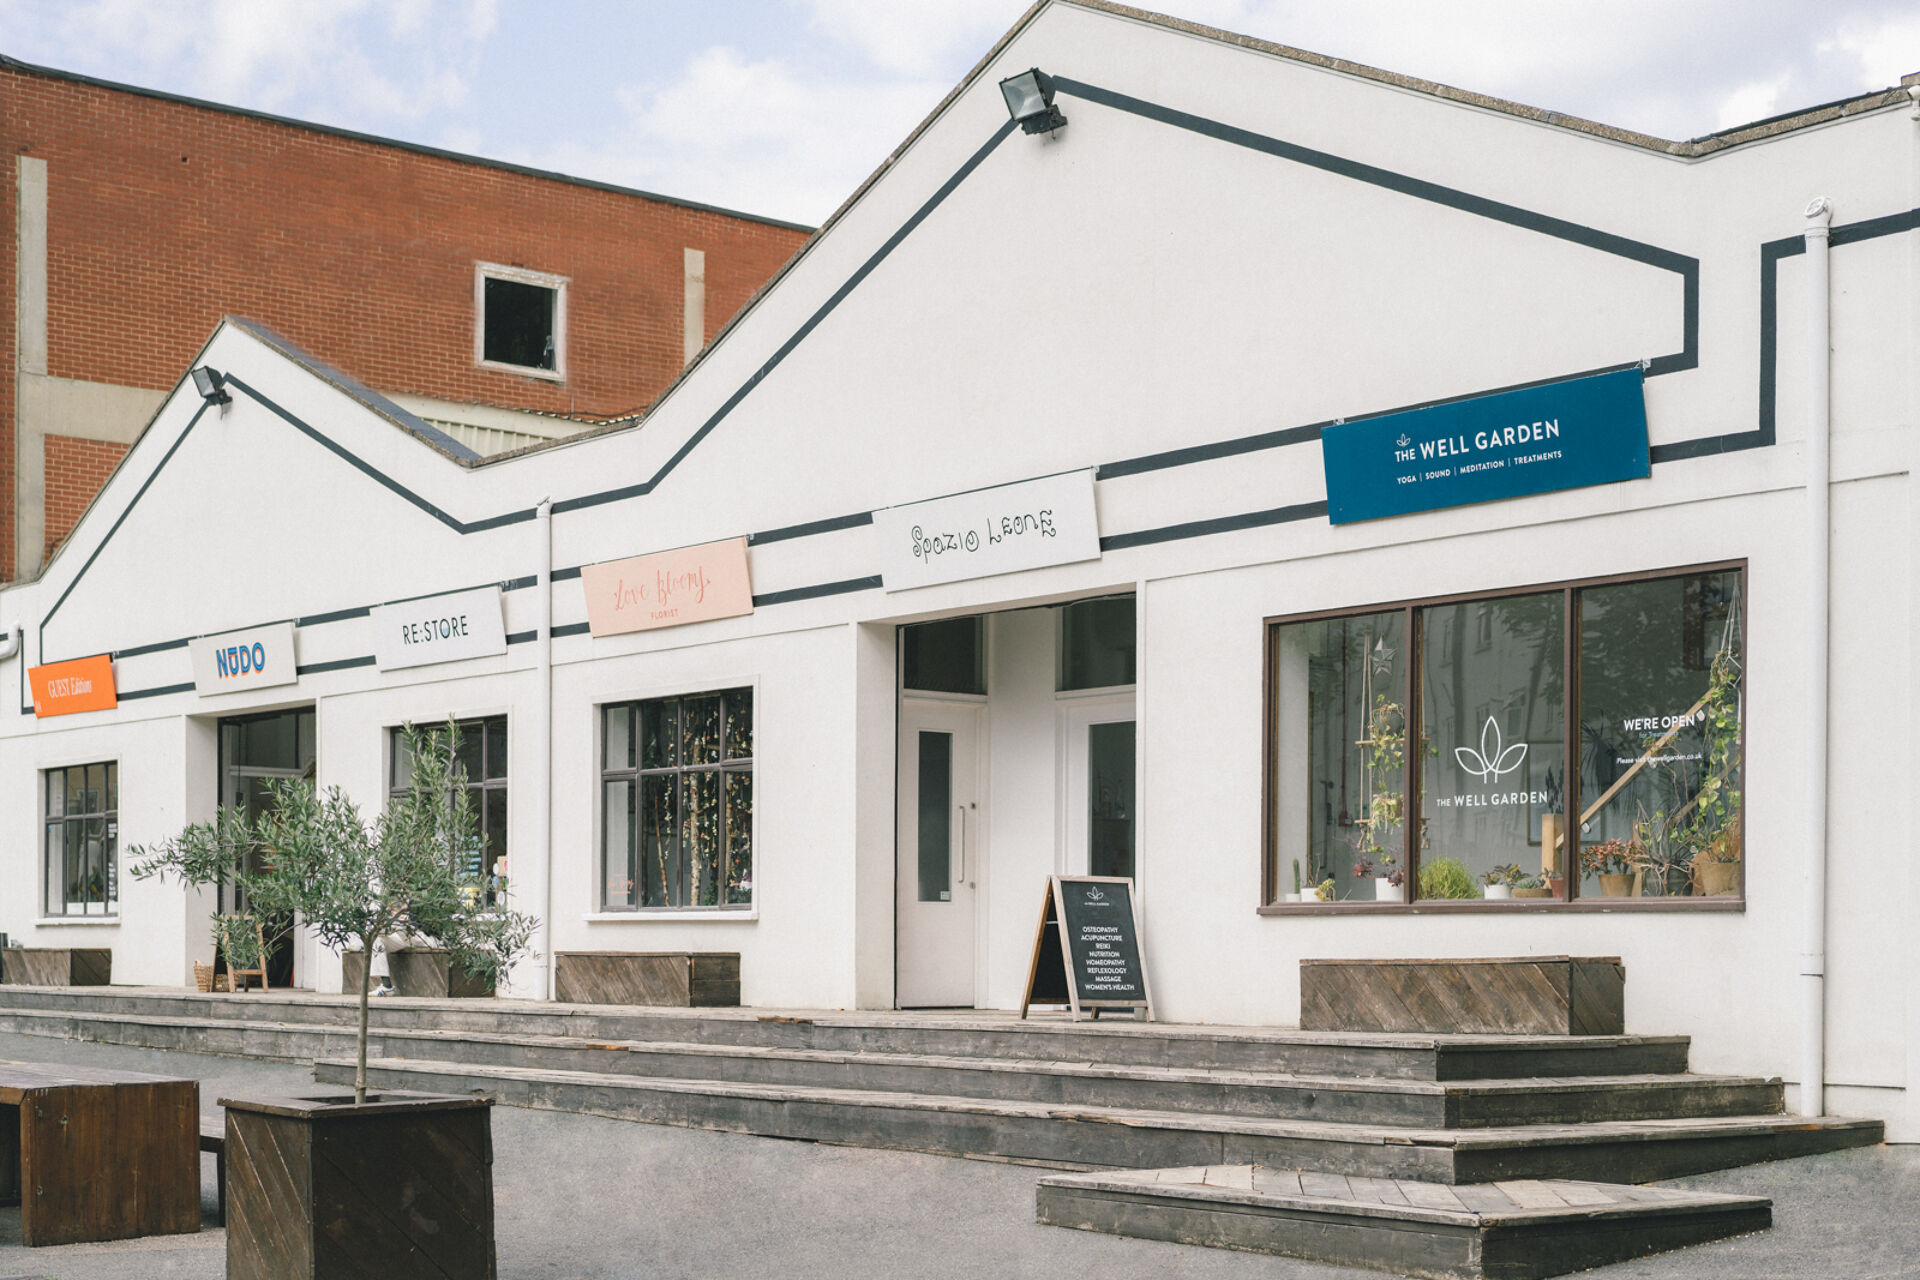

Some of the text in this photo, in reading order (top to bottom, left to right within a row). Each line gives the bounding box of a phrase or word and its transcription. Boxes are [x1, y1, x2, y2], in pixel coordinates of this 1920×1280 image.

[1394, 418, 1560, 463] THE WELL GARDEN
[1397, 450, 1563, 485] YOGA SOUND MEDITATION TREATMENTS
[650, 608, 679, 620] FLORIST
[402, 614, 469, 646] RE:STORE
[47, 677, 71, 699] GUEST
[1623, 714, 1696, 731] WE'RE OPEN
[1436, 791, 1548, 807] THE WELL GARDEN
